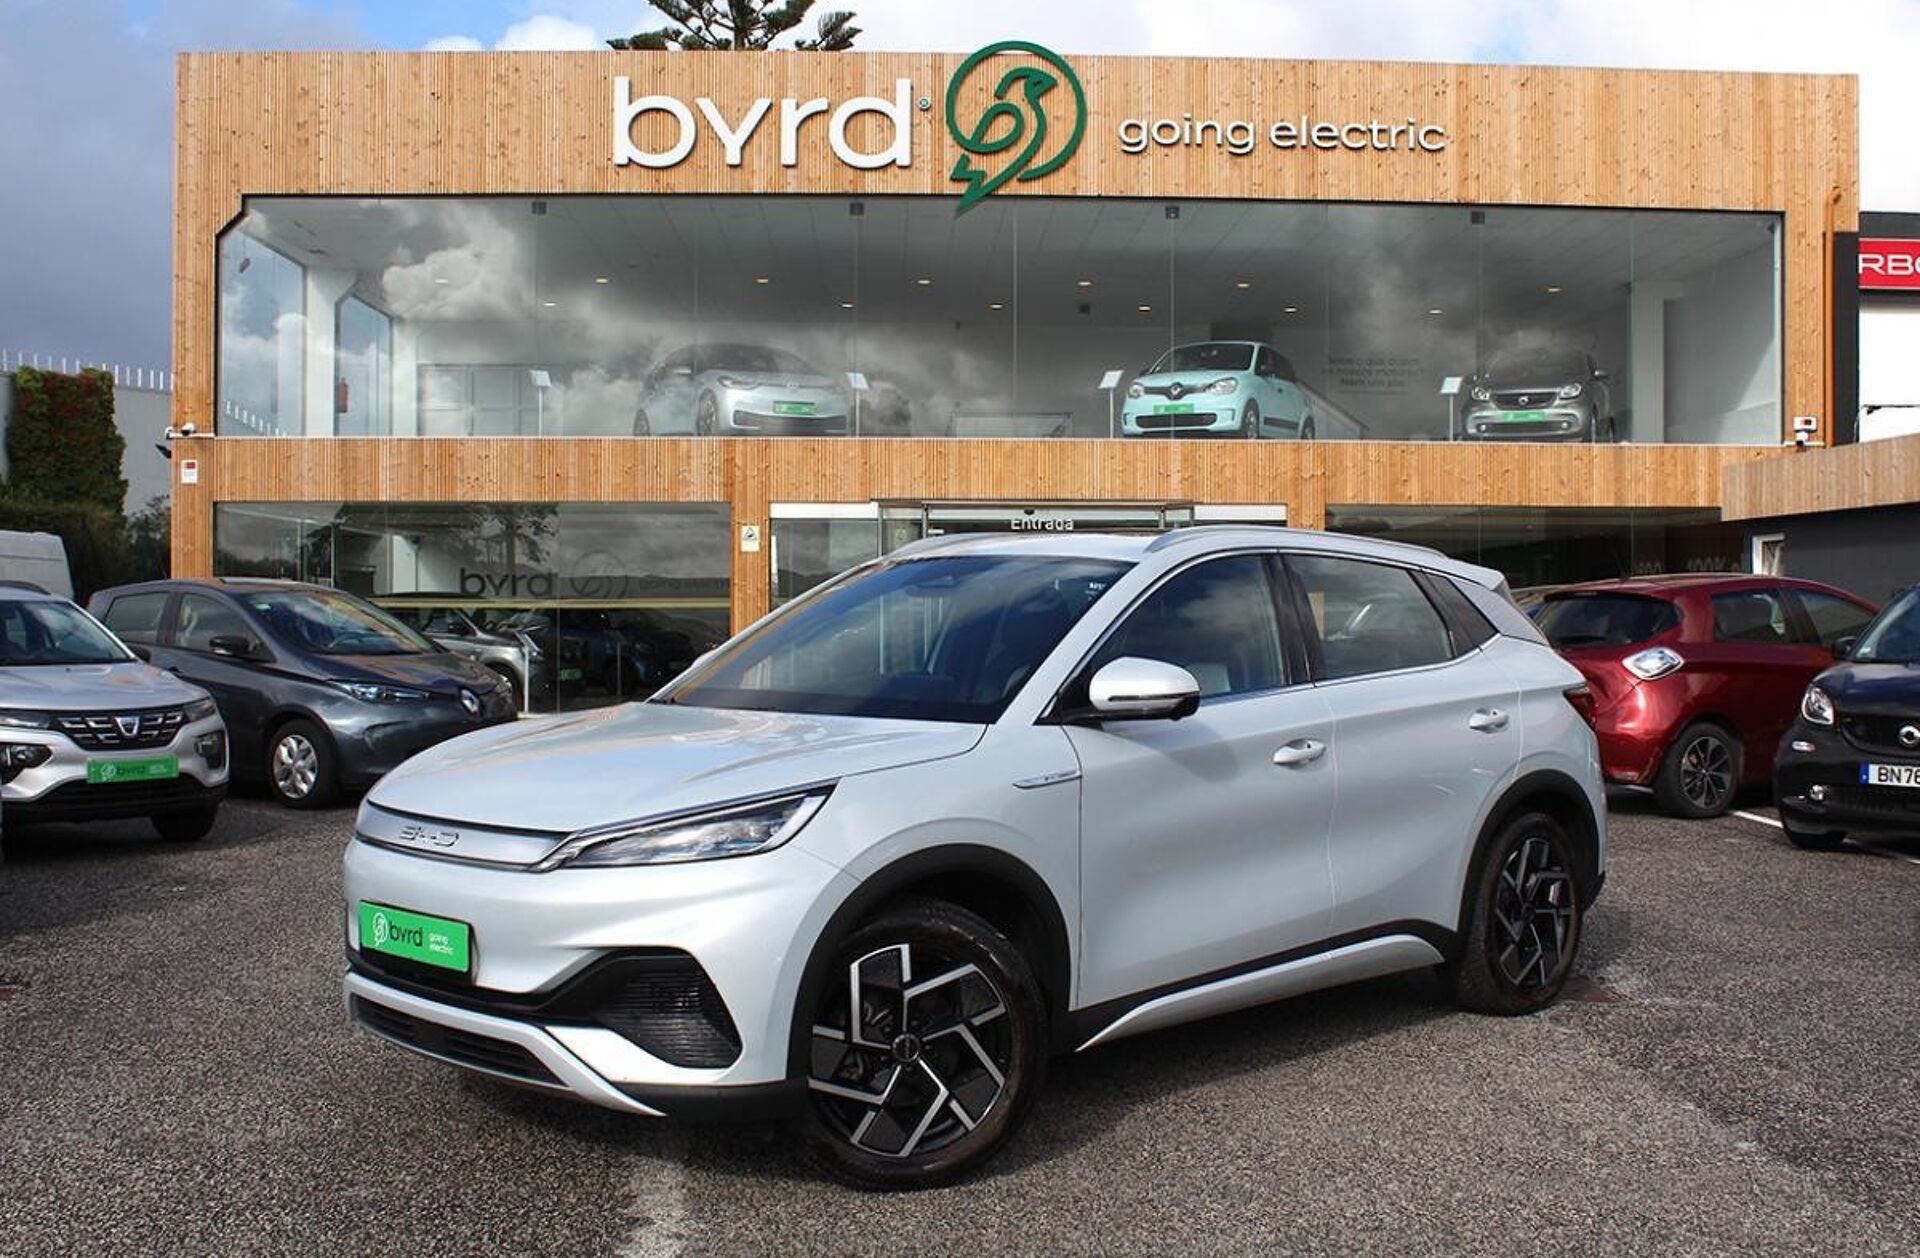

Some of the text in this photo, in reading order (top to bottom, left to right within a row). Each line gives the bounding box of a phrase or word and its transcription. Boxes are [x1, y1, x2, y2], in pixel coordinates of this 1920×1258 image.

[613, 75, 912, 169] byrd
[1118, 112, 1447, 155] going electric
[1858, 253, 1920, 276] RB
[1010, 517, 1075, 531] Entrada
[388, 919, 425, 948] byrd
